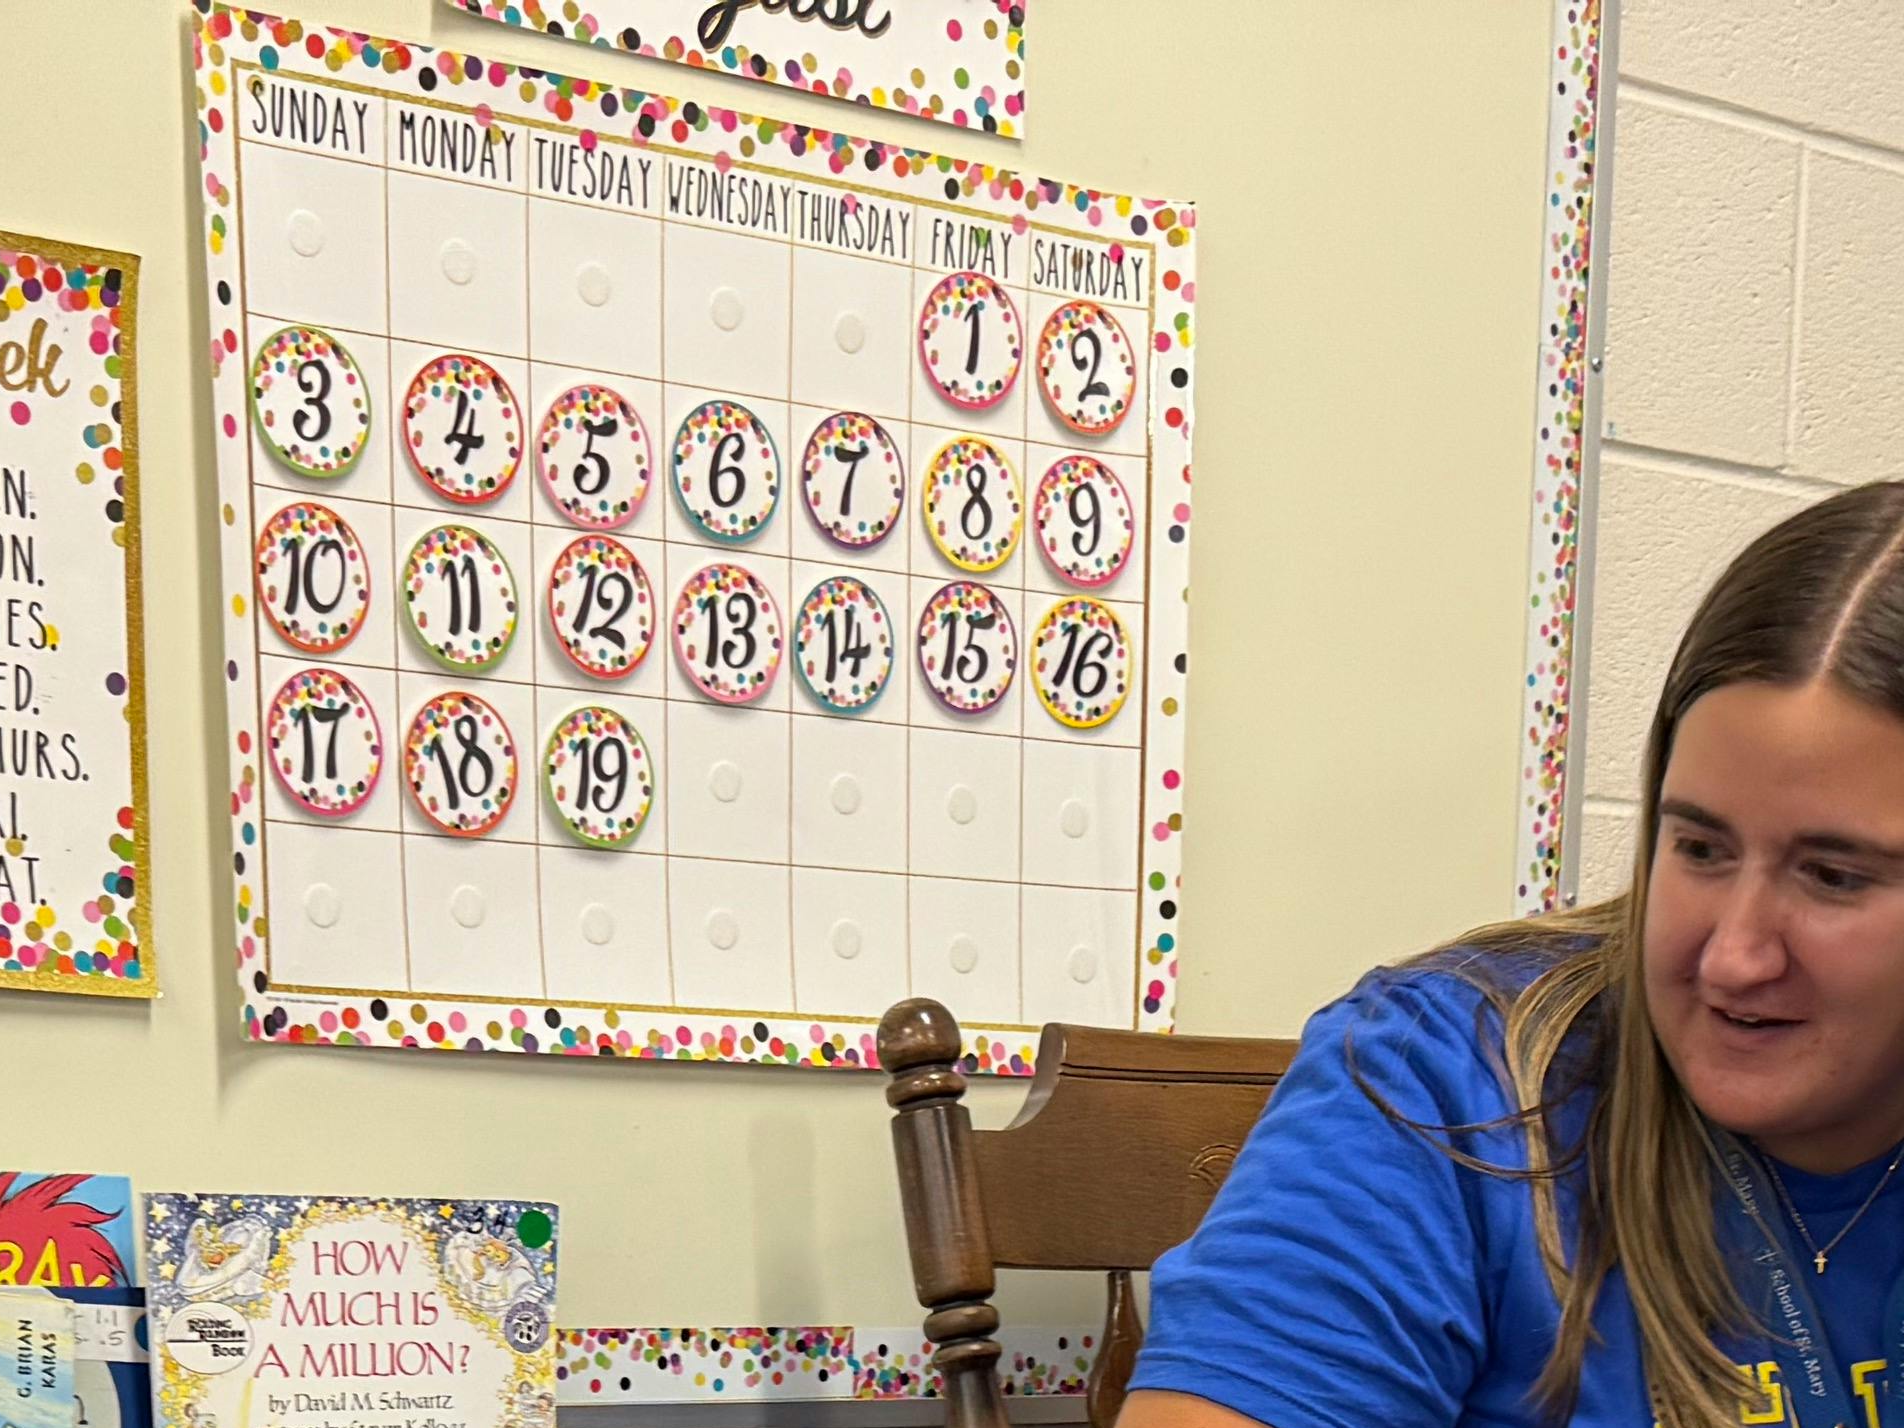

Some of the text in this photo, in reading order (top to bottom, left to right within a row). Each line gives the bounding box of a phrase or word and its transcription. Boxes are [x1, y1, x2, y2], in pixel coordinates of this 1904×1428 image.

[250, 78, 370, 156] SUNDAY
[399, 110, 516, 183] MONDAY
[534, 135, 653, 210] TUESDAY
[667, 161, 792, 234] WEDNESDAY
[795, 189, 912, 258] THURSDAY
[930, 217, 1013, 281] FRIDAY
[1033, 238, 1146, 304] SATURDAY
[961, 302, 983, 376] 1
[1072, 325, 1108, 401] 2
[296, 357, 333, 444] 3
[444, 387, 486, 467] 4
[571, 418, 620, 495] 5
[708, 431, 745, 509] 6
[834, 444, 868, 517] 7
[959, 463, 995, 542] 8
[1069, 475, 1101, 554] 9
[281, 537, 347, 618] 10
[444, 553, 480, 636] 11
[571, 565, 636, 650] 12
[703, 591, 758, 671] 13
[821, 607, 872, 684] 14
[939, 610, 991, 686] 15
[1052, 622, 1110, 698] 16
[291, 700, 351, 784] 17
[430, 713, 494, 800] 18
[571, 731, 630, 814] 19
[312, 1240, 409, 1276] HOW
[280, 1291, 441, 1327] MUCH IS
[17, 1319, 33, 1398] G. BRIAN
[41, 1332, 57, 1389] KARAS
[211, 1343, 246, 1357] BOOK
[252, 1341, 471, 1379] A MILLION?
[1804, 1358, 1827, 1397] Mary
[269, 1394, 290, 1415] by
[295, 1393, 346, 1412] David
[378, 1391, 454, 1411] Schwartz
